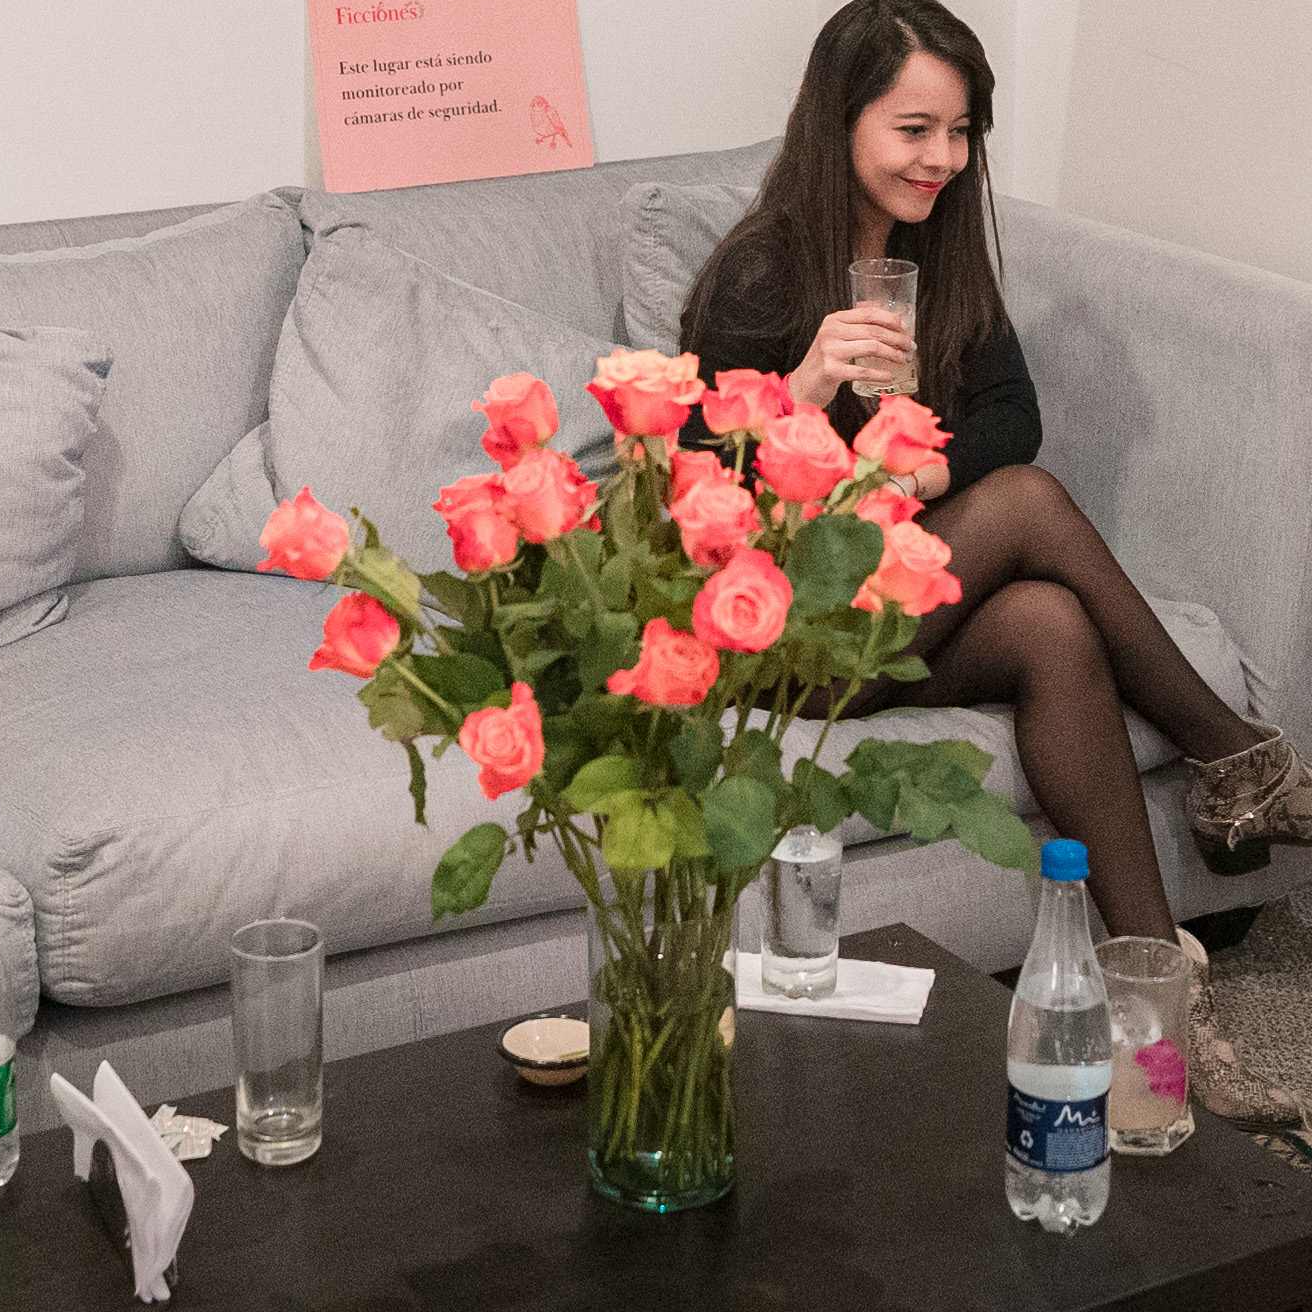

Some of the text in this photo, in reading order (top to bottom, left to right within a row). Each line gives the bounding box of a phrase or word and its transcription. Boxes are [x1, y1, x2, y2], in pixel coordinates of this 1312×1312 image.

[339, 50, 493, 76] Este lugar está siendo
[341, 80, 464, 100] monitoreado por
[344, 99, 502, 127] cámaras de seguridad.
